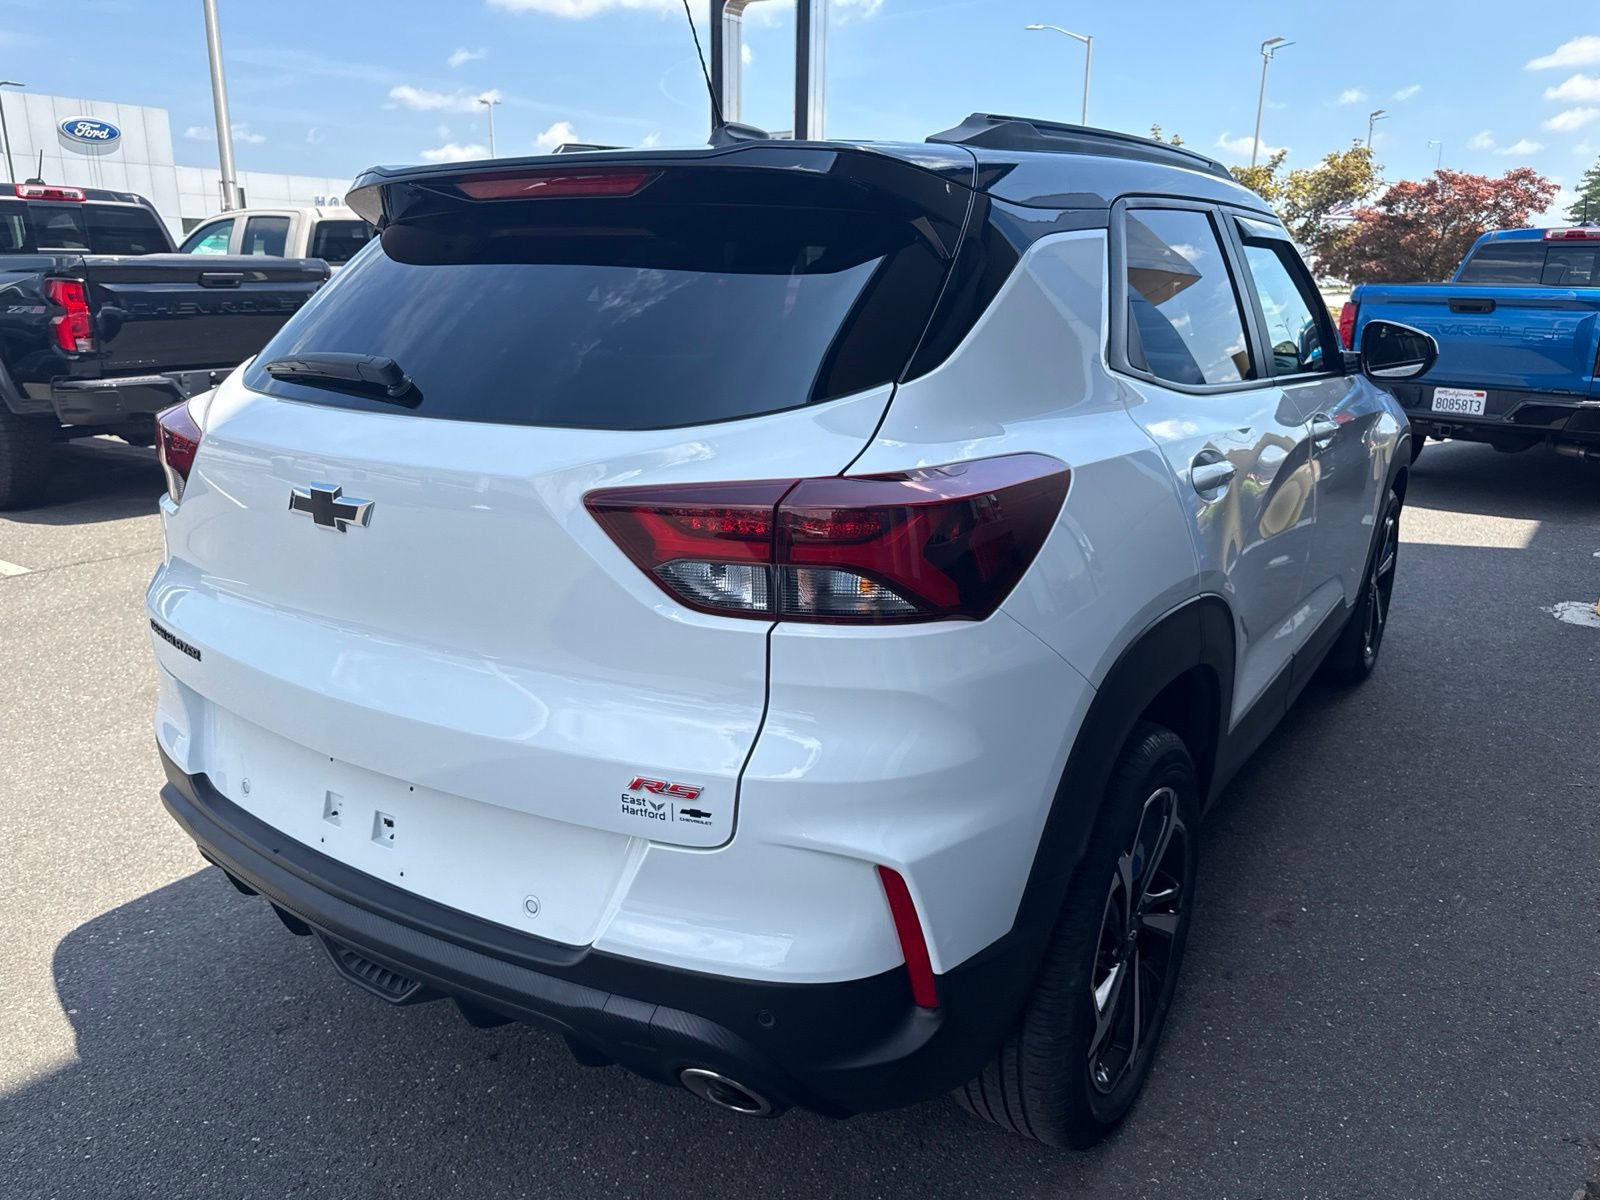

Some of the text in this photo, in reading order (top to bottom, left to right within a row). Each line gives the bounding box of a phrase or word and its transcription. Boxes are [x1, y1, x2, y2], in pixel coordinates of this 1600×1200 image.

[74, 121, 110, 139] Ford
[314, 195, 346, 207] HO
[131, 298, 302, 315] CHEVROLE
[1435, 397, 1482, 413] 80858T3
[626, 775, 705, 801] RS
[621, 793, 647, 807] East
[621, 804, 667, 821] Hartford
